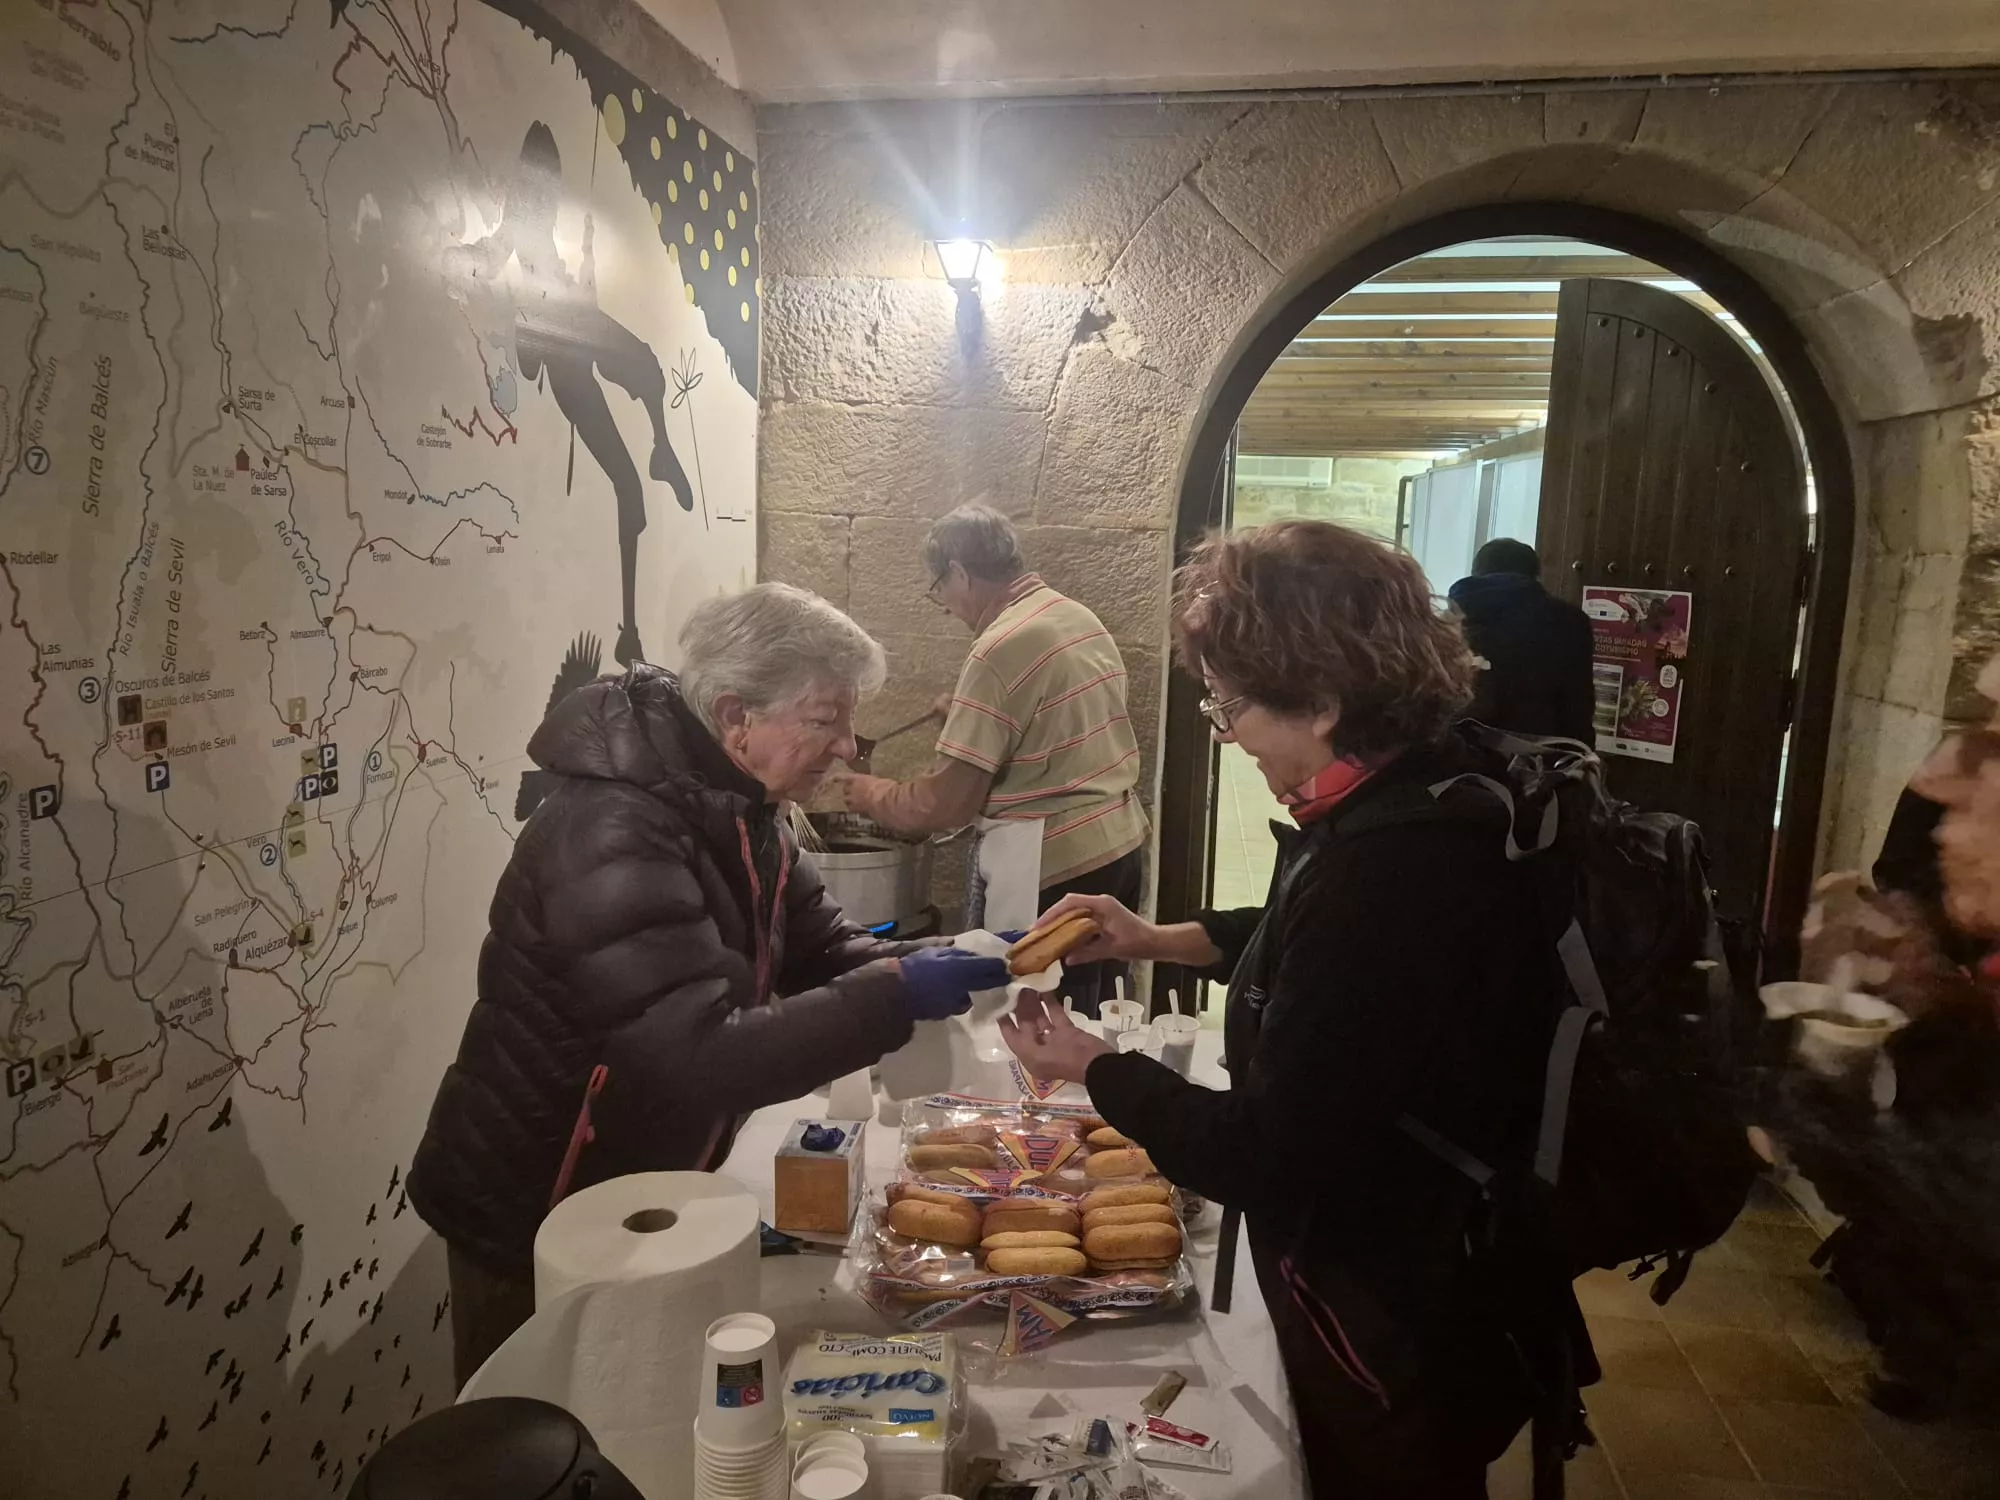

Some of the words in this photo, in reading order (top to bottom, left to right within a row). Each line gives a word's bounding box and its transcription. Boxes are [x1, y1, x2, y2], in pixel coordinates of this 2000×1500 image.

[90, 353, 112, 420] Balcés
[87, 425, 106, 451] de
[31, 452, 43, 470] 7
[81, 456, 104, 518] Sierra
[264, 485, 287, 497] Sarsa
[10, 551, 59, 565] Rodellar
[168, 537, 186, 585] Sevil
[292, 547, 314, 585] Vero
[165, 589, 182, 614] de
[161, 618, 179, 674] Sierra
[84, 682, 96, 700] 3
[245, 936, 288, 962] Alquézar
